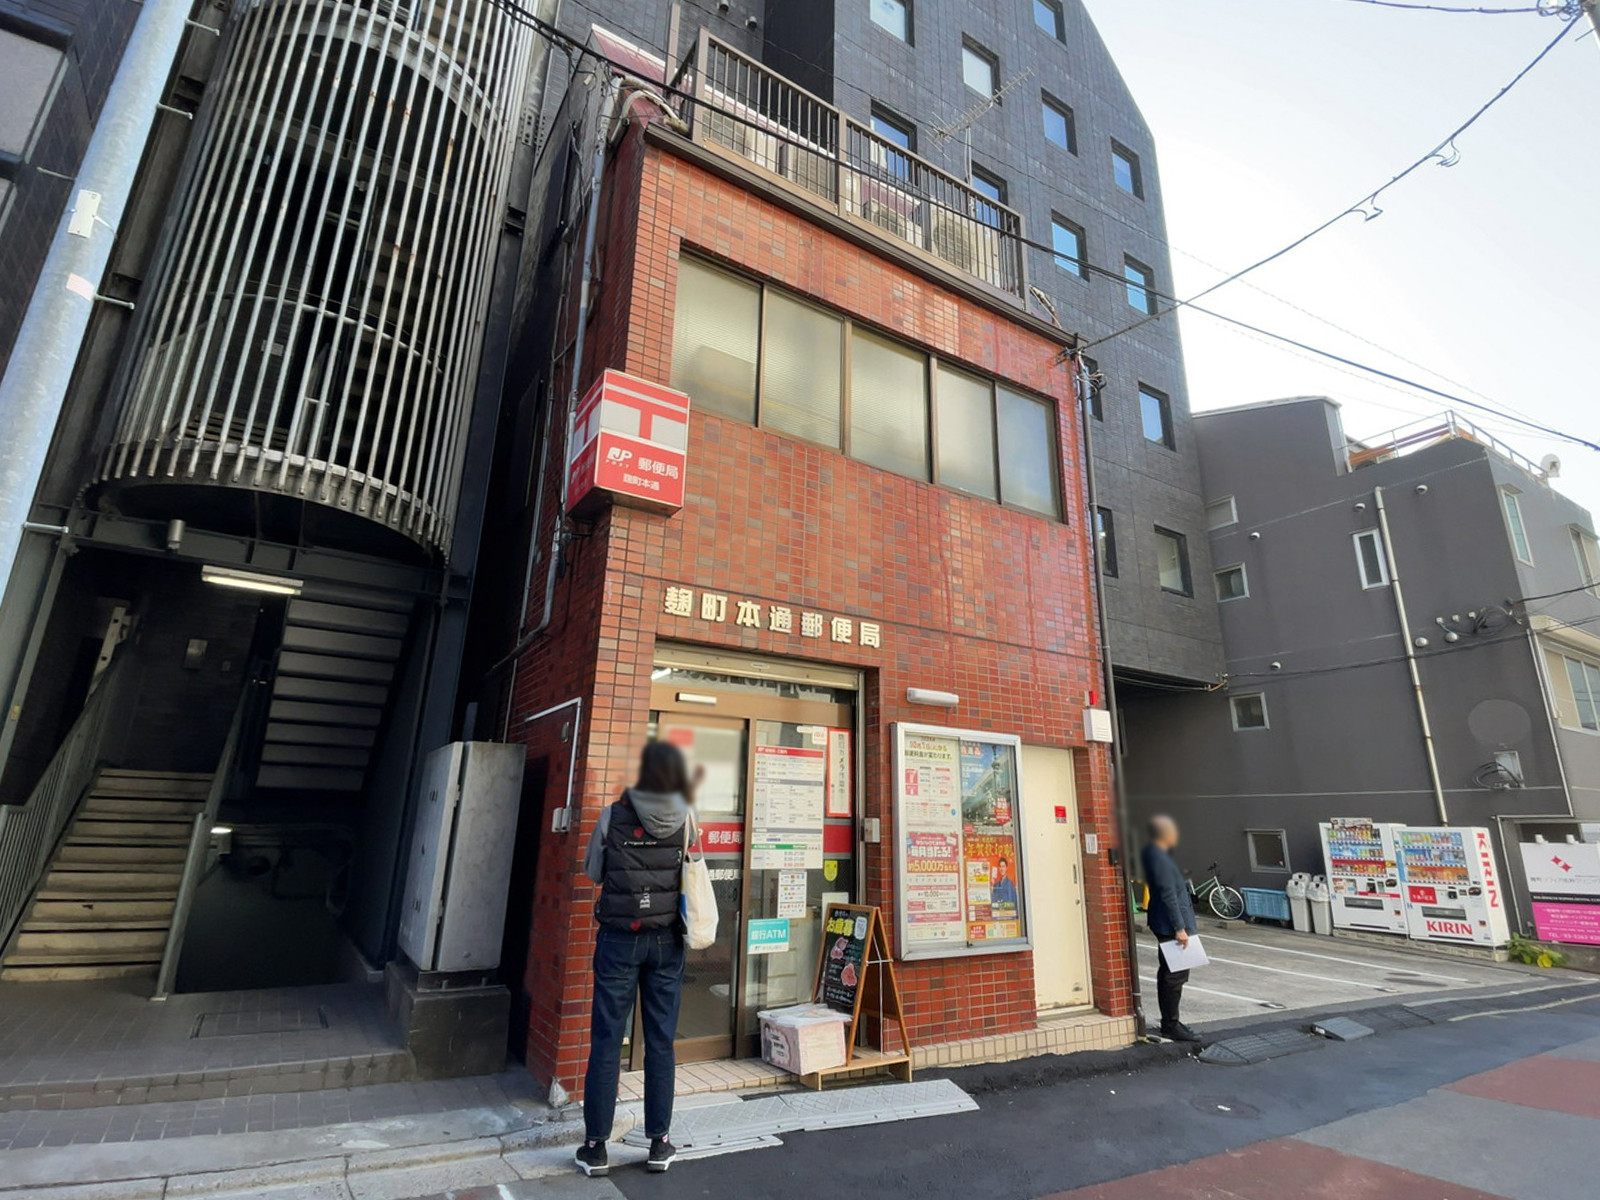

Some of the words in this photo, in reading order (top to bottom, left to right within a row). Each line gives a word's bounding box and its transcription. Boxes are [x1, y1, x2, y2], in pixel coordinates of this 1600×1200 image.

[638, 456, 679, 480] 郵便局
[1427, 920, 1473, 935] KIRIN
